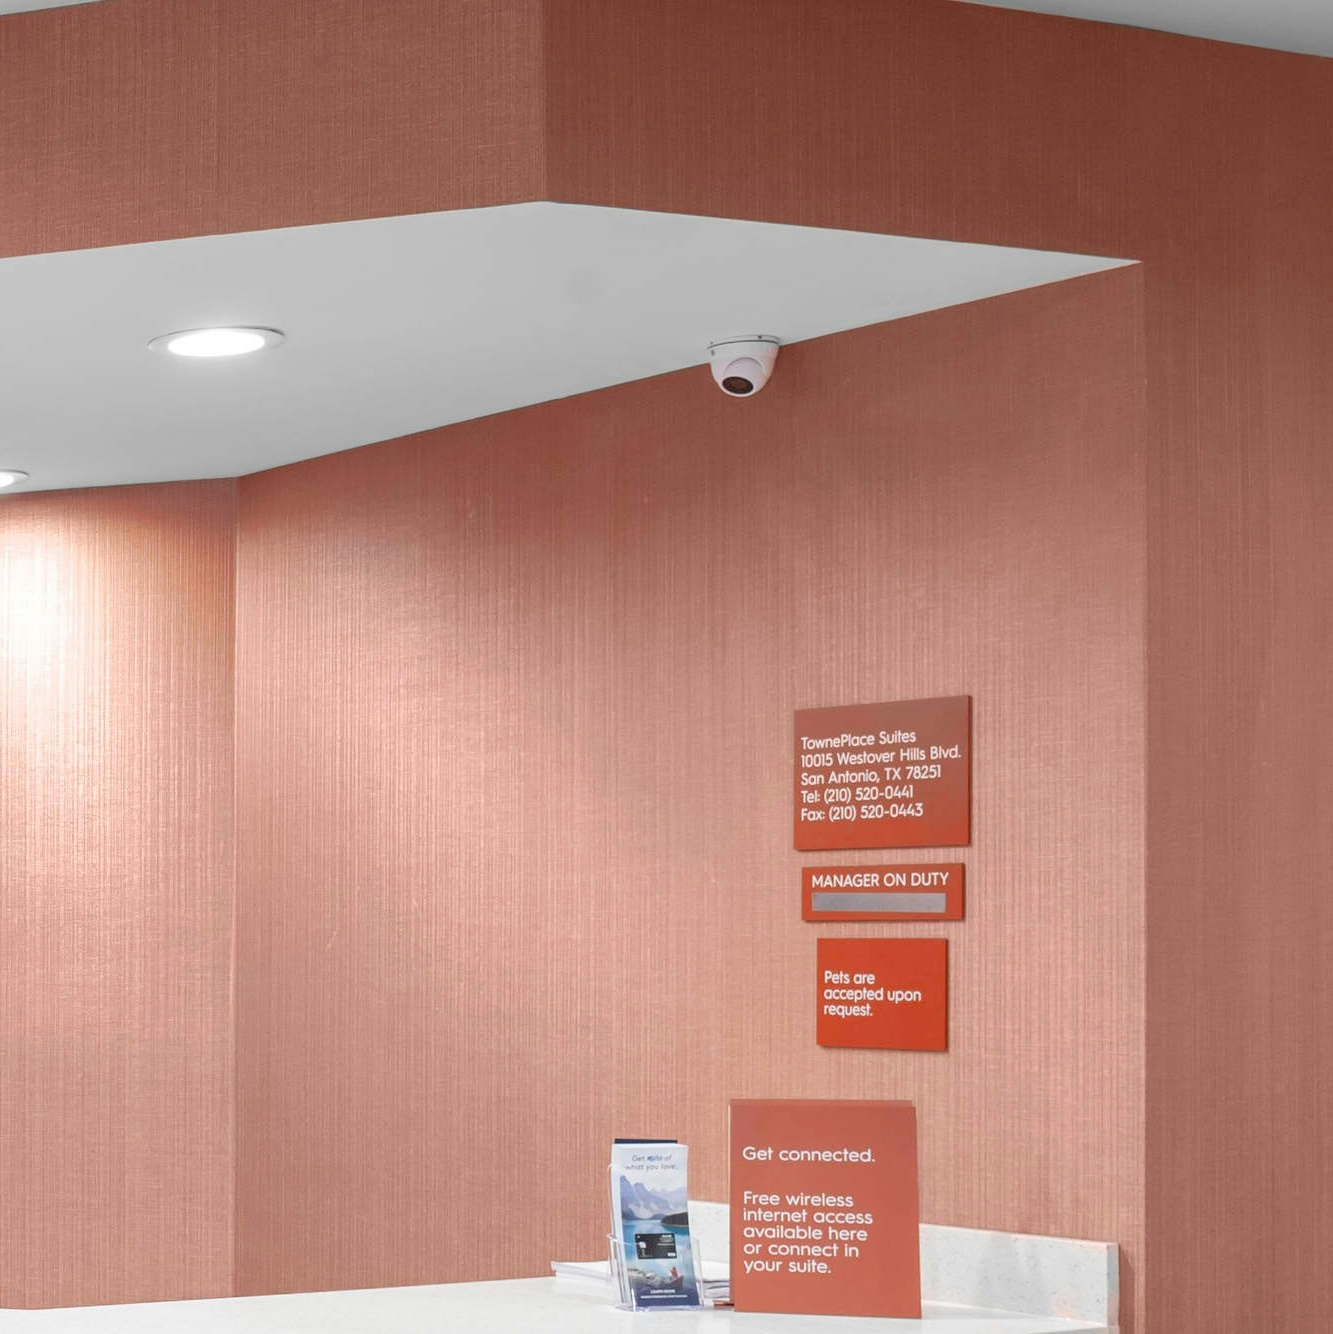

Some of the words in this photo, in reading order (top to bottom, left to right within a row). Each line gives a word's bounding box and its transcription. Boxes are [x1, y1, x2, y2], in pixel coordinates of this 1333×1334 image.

[801, 734, 875, 749] TownePlace
[879, 730, 916, 744] Suites
[801, 753, 833, 768] 10015
[837, 751, 895, 765] Westover
[900, 748, 926, 761] Hills
[930, 745, 961, 759] Blvd.
[801, 773, 824, 785] San
[828, 769, 880, 784] Antonio,
[884, 767, 901, 780] TX
[906, 765, 941, 779] 78251
[801, 790, 820, 803] Tel:
[824, 787, 851, 804] (210)
[855, 785, 913, 801] 520-0441
[801, 808, 825, 821] Fax:
[829, 805, 856, 822] (210)
[861, 803, 923, 819] 520-0443
[812, 873, 879, 887] MANAGER
[884, 873, 906, 886] ON
[911, 872, 949, 886] DUTY
[825, 971, 850, 984] Pets
[853, 974, 875, 984] are
[824, 987, 883, 1003] accepted
[887, 990, 921, 1004] upon
[824, 1003, 872, 1018] request.
[743, 1146, 773, 1160] Get
[779, 1148, 875, 1162] connected.
[744, 1191, 780, 1205] Free
[786, 1193, 853, 1207] wireless
[744, 1208, 807, 1222] internet
[813, 1212, 873, 1224] access
[743, 1225, 823, 1239] available
[829, 1227, 867, 1241] here
[744, 1243, 762, 1254] or
[768, 1243, 838, 1257] connect
[845, 1244, 859, 1257] in
[744, 1261, 782, 1273] your
[789, 1259, 831, 1273] suite.
